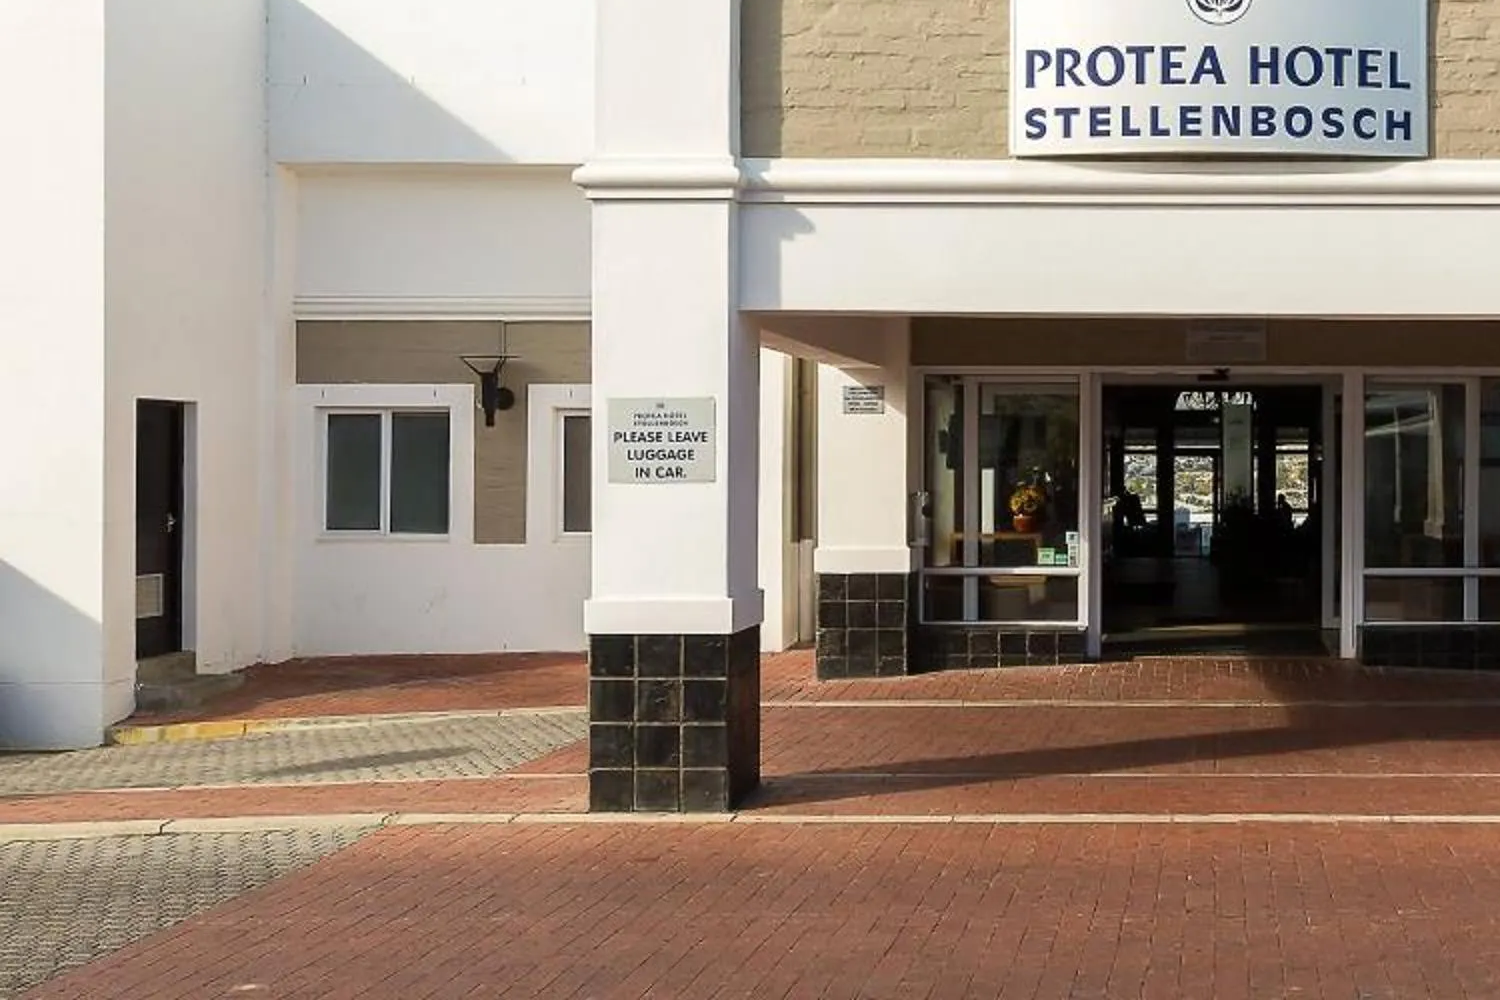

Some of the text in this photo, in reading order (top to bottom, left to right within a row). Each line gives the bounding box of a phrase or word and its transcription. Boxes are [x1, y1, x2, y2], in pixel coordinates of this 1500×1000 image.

[1024, 45, 1411, 89] PROTEA HOTEL
[1024, 105, 1412, 141] STELLENBOSCH
[613, 431, 708, 443] PLEASE LEAVE
[627, 449, 695, 461] LUGGAGE
[635, 466, 687, 479] IN CAR.
